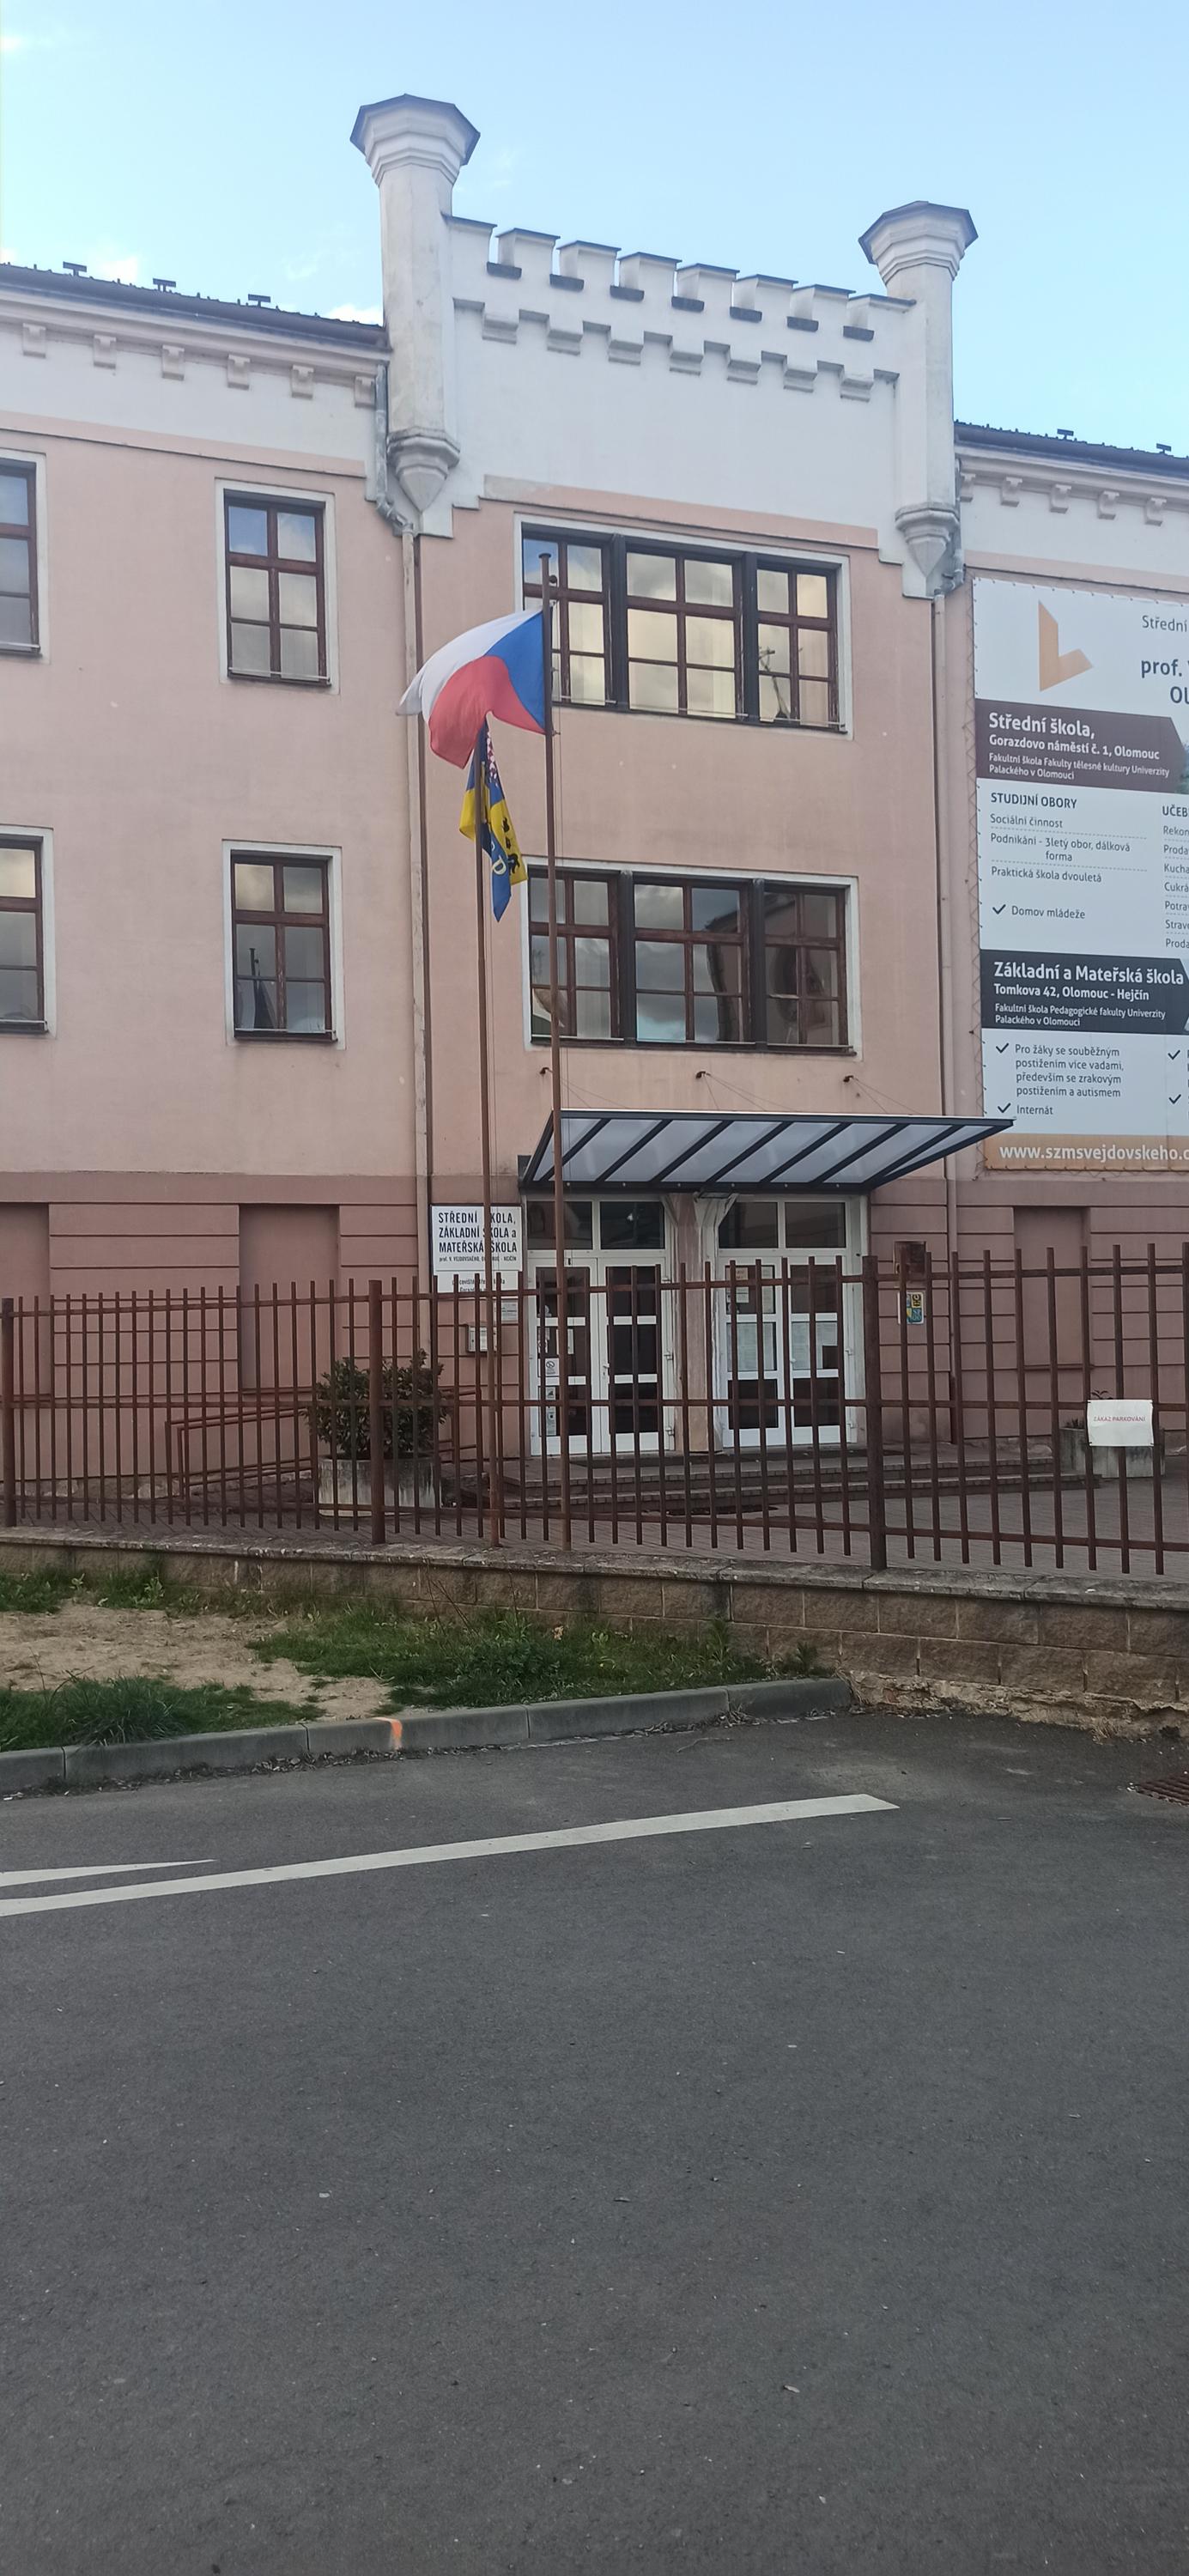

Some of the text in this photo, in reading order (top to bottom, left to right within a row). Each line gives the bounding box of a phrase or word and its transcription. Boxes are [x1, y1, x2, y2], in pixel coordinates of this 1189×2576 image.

[1142, 614, 1187, 633] Střední
[1141, 659, 1182, 678] prof.
[989, 712, 1095, 740] Střední škola,
[989, 734, 1160, 760] Gorazdovo náměstí č. 1, Olomouc
[989, 752, 1170, 778] Fakultní škola Fakulty tělesné kultury Univerzity
[989, 764, 1029, 777] Palackého
[1037, 769, 1075, 781] Olomouci
[991, 792, 1077, 809] STUDIJNÍ OBORY
[990, 813, 1064, 829] Sociální činnost
[991, 833, 1037, 846] Podnikání
[1045, 837, 1069, 850] 3letý
[1071, 839, 1094, 851] obor,
[1095, 841, 1131, 853] dálková
[1045, 852, 1073, 862] forma
[991, 866, 1102, 883] Praktická škola dvouletá
[1011, 905, 1086, 919] Domov mládeže
[994, 961, 1184, 985] Základní a Mateřská škola
[993, 983, 1040, 997] Tomkova
[1043, 986, 1060, 998] 42,
[1062, 986, 1109, 999] Olomouc
[1117, 988, 1150, 1002] Hejčín
[995, 1003, 1166, 1020] Fakultní škola Pedagogické fakulty Univerzity
[995, 1014, 1036, 1026] Palackého
[1043, 1018, 1081, 1027] Olomouci
[1015, 1043, 1030, 1054] Pro
[1033, 1044, 1054, 1057] žáky
[1068, 1046, 1119, 1058] souběžným
[1016, 1059, 1125, 1072] postižením více vadami,
[1016, 1072, 1065, 1084] především
[1078, 1074, 1121, 1086] zrakovým
[1016, 1086, 1067, 1098] postižením
[1077, 1089, 1121, 1097] autismem
[1016, 1105, 1053, 1115] Internát
[439, 1211, 516, 1224] STŘEDNÍ KOLA,
[439, 1225, 480, 1238] ZÁKLADNÍ
[512, 1230, 517, 1238] a
[439, 1241, 517, 1253] MATEŘSKÁ ŠKOLA
